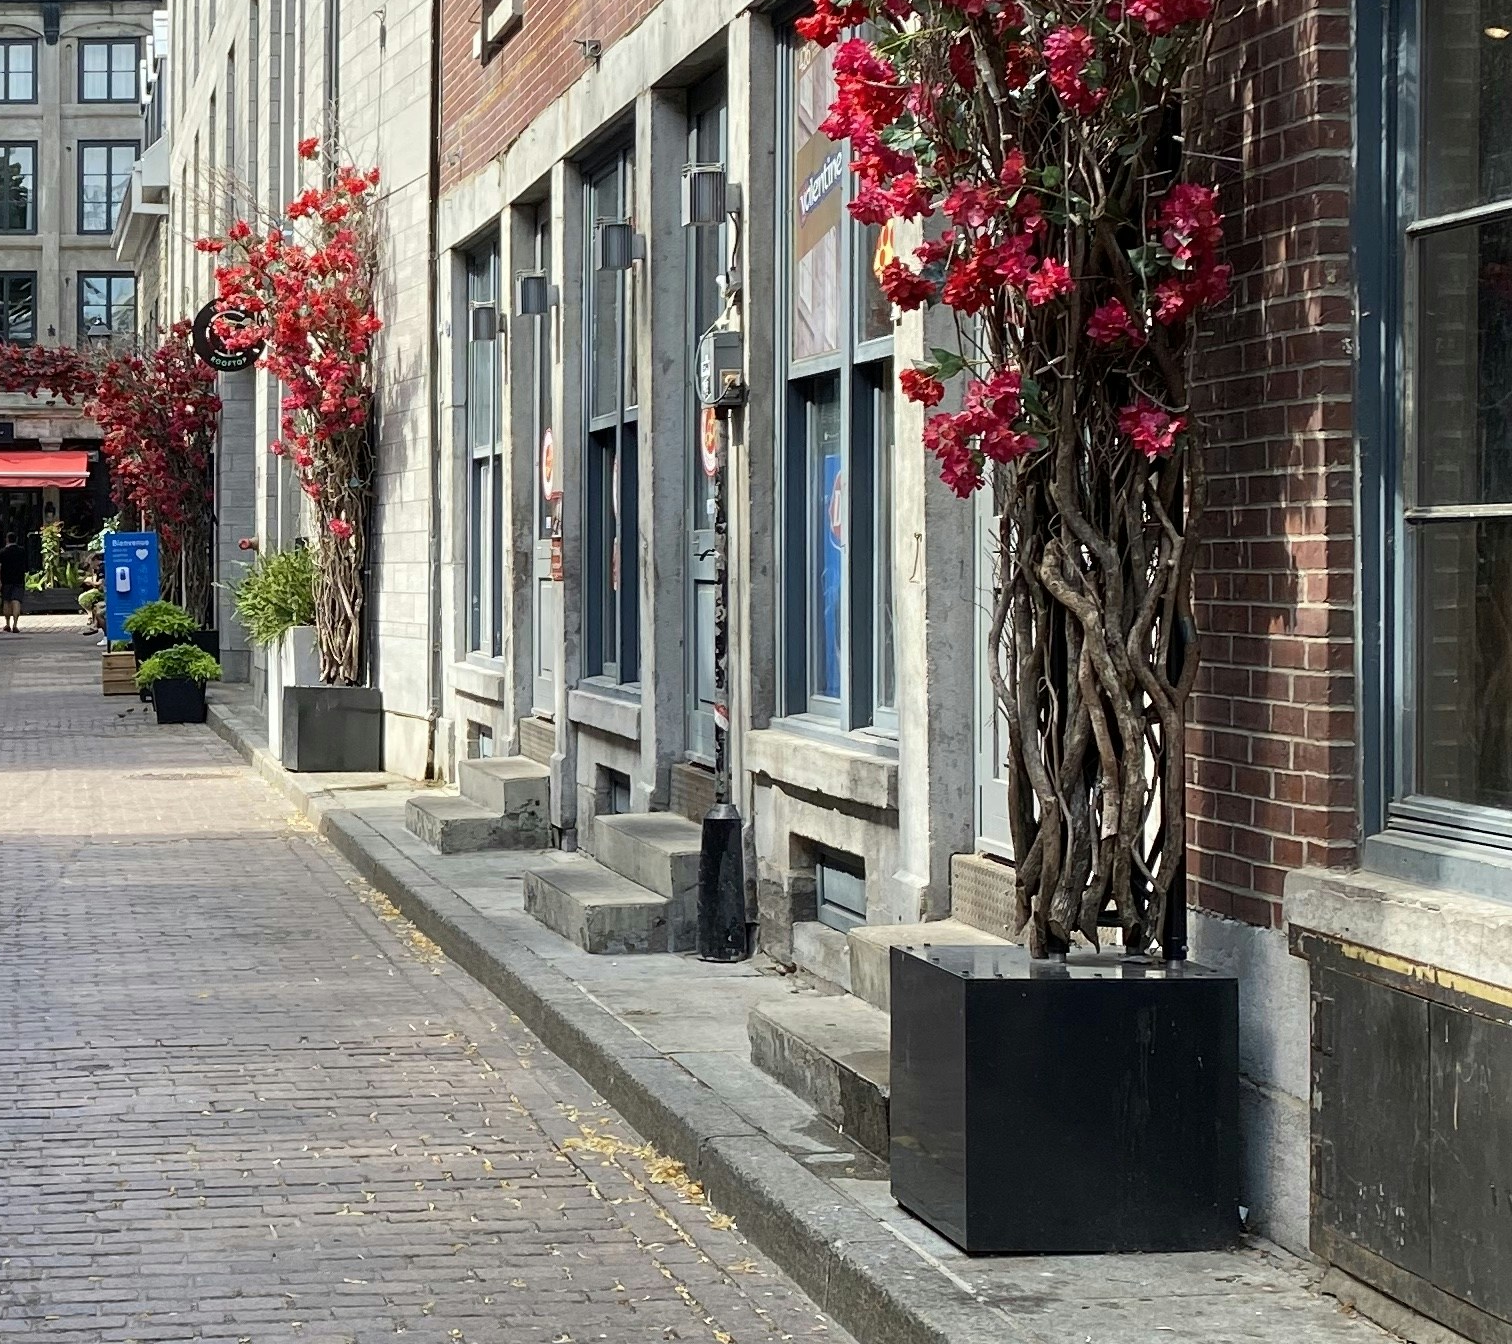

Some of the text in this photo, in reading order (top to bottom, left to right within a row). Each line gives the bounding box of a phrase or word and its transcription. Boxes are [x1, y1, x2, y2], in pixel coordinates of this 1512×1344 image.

[799, 151, 843, 215] valentine
[210, 356, 247, 367] ROOFTOP
[112, 539, 150, 547] Bienvenue
